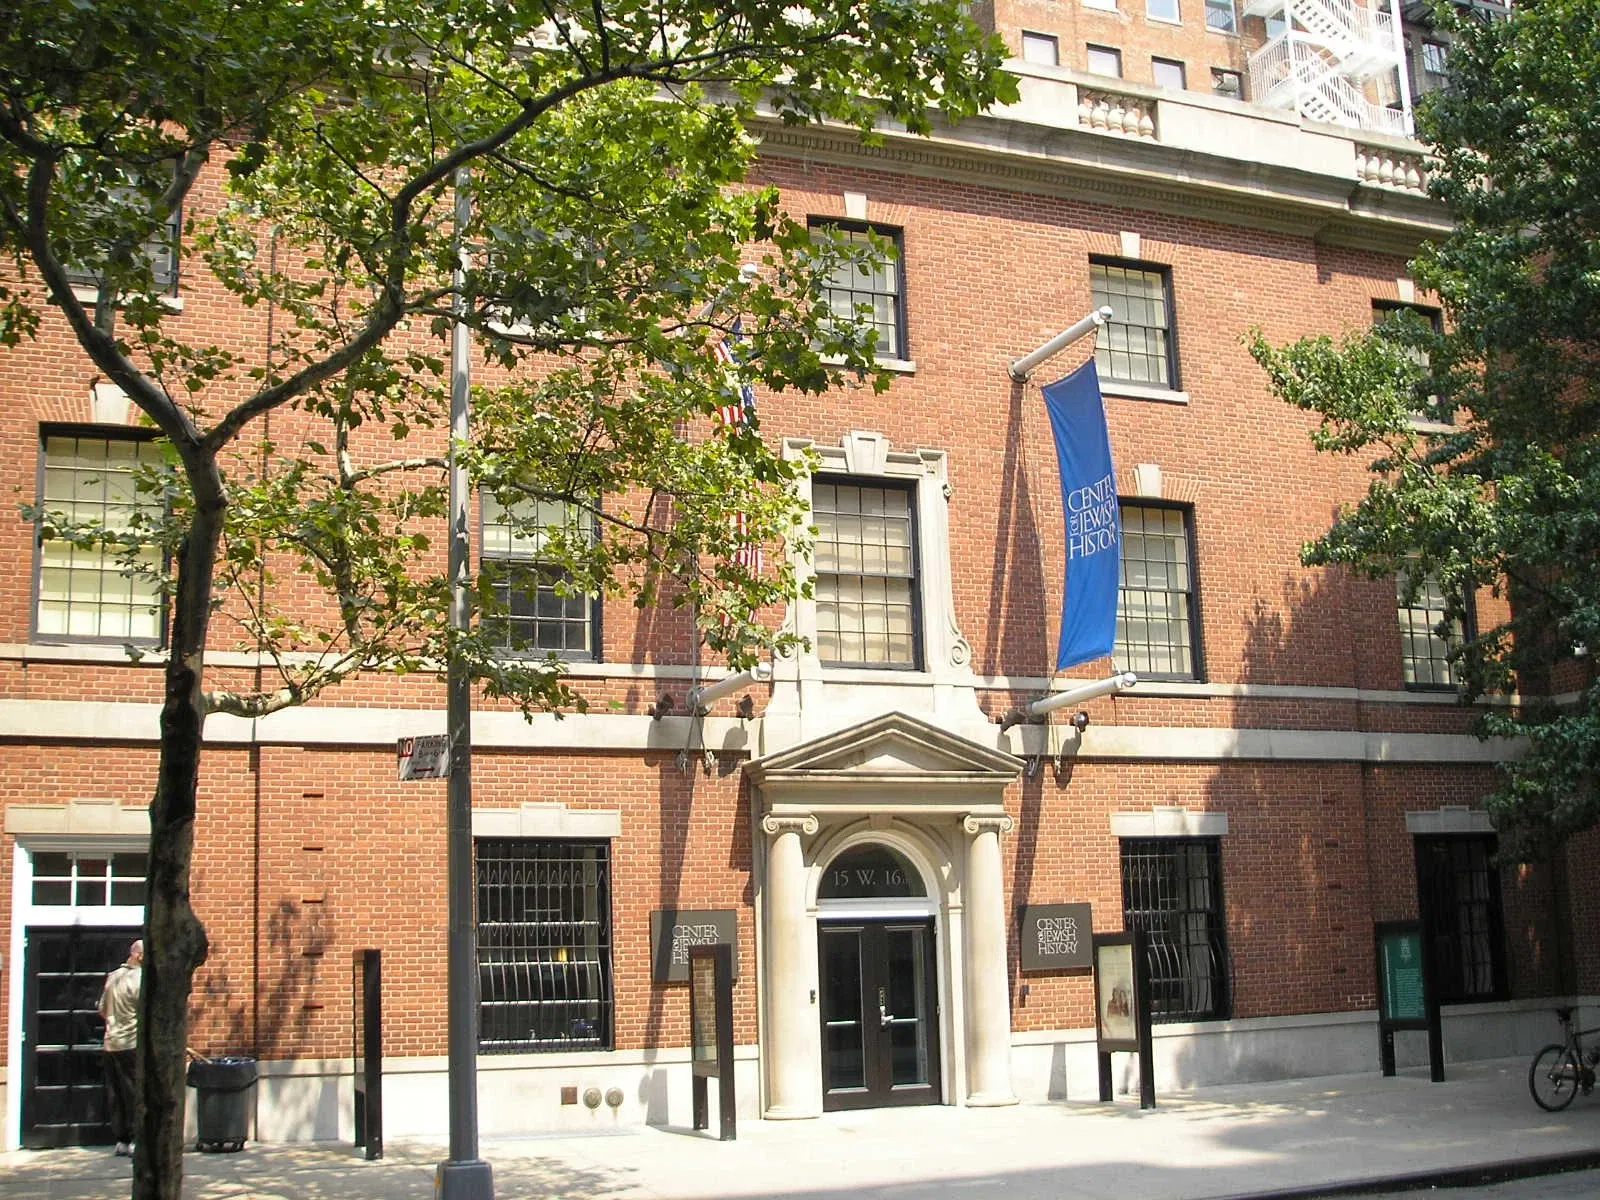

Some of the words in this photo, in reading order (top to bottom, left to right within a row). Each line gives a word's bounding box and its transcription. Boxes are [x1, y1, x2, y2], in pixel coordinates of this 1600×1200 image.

[399, 739, 413, 756] NO
[833, 870, 849, 886] 15
[856, 868, 876, 885] W.
[672, 924, 720, 938] CENTER
[1036, 917, 1078, 930] CENTER
[1043, 929, 1076, 943] JEWISH
[1038, 940, 1078, 956] HISTORY
